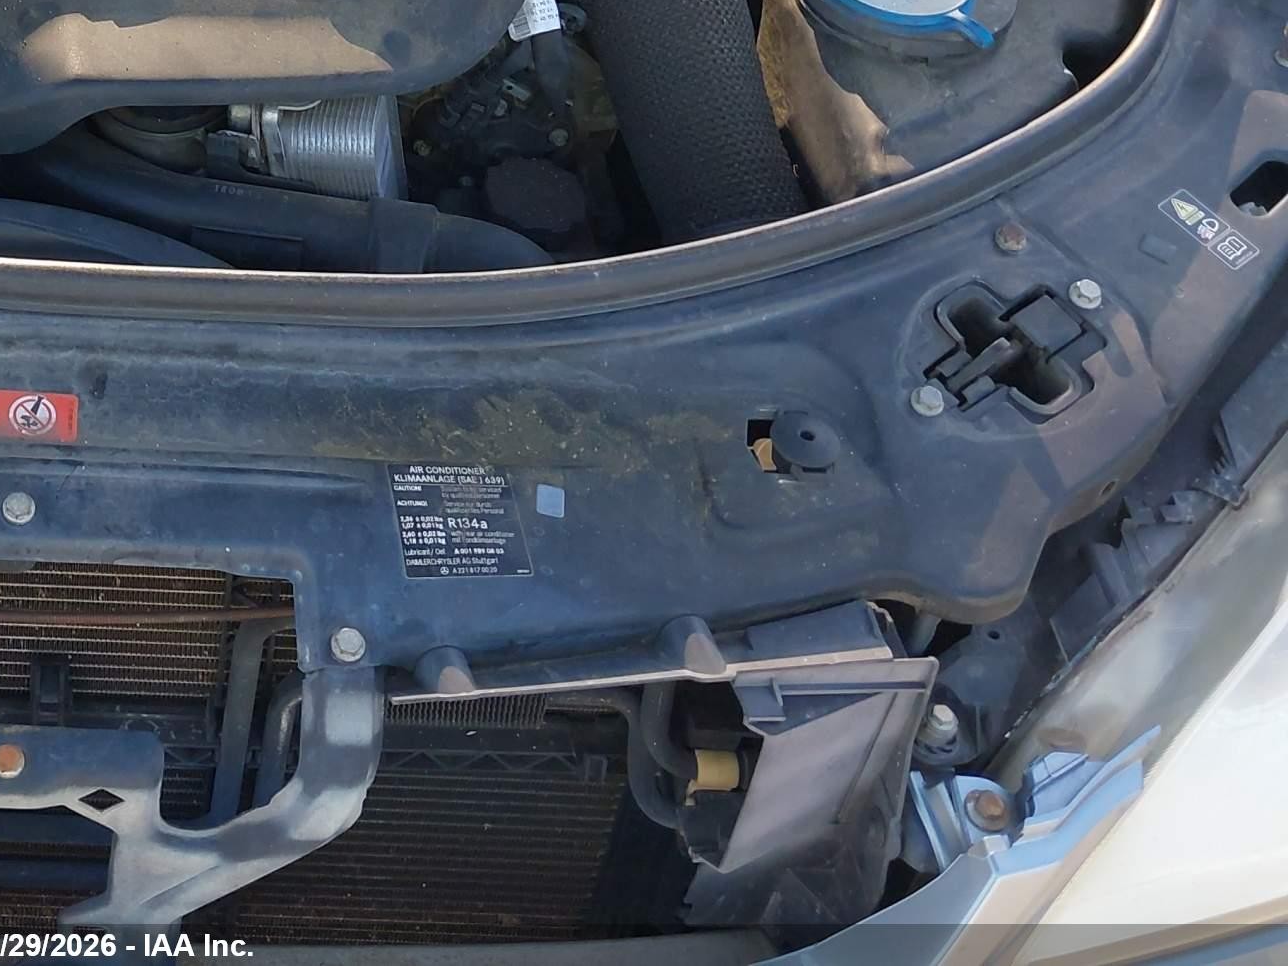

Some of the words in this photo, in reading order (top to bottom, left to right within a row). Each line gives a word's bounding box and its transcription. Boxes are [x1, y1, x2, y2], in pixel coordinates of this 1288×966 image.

[409, 465, 424, 474] AIR
[426, 466, 486, 475] CONDITIONER
[393, 474, 456, 483] KLIMAANLAGE
[447, 518, 488, 529] R134a
